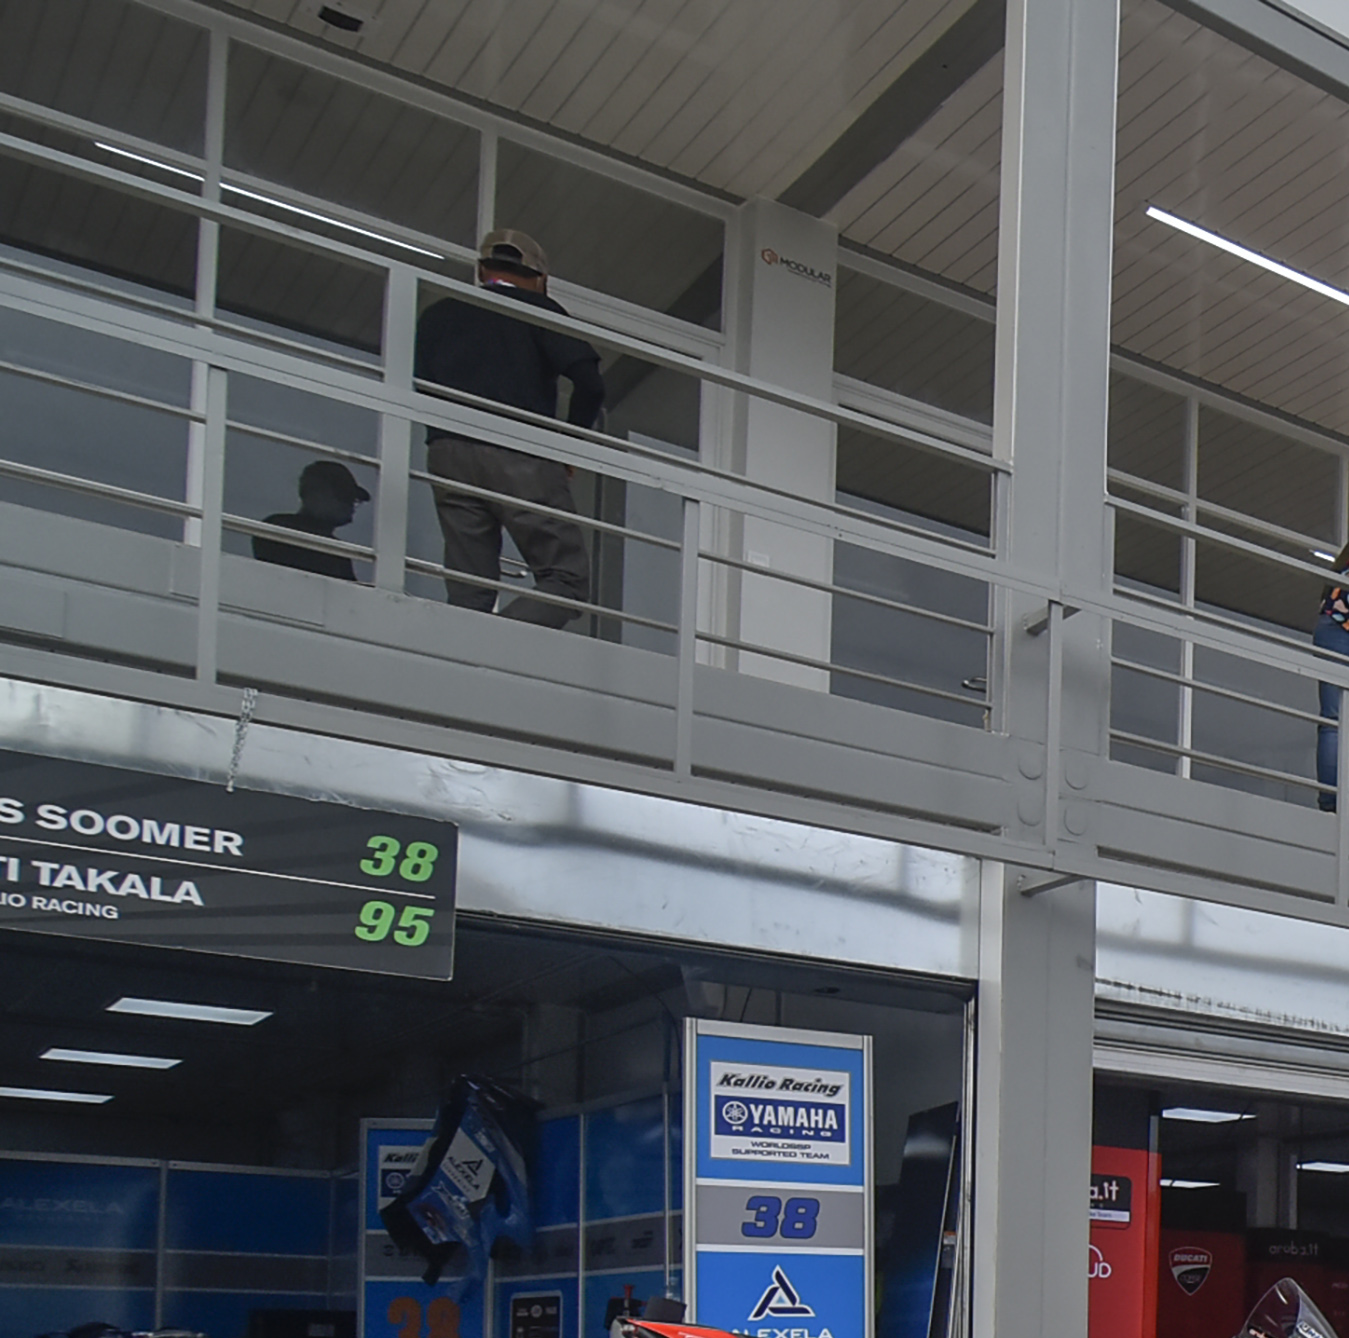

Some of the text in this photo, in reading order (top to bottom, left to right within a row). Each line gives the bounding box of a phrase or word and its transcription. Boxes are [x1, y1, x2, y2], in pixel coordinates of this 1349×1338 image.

[780, 257, 832, 284] MODULAR
[35, 804, 244, 857] SOOMER
[360, 835, 439, 882] 38
[31, 860, 205, 907] TAKALA
[32, 896, 119, 919] RACING
[355, 901, 434, 946] 95
[717, 1073, 843, 1097] Kallio Racing
[750, 1104, 838, 1130] YAMAHA
[732, 1126, 832, 1137] RACING
[800, 1151, 829, 1159] TEAM
[741, 1196, 820, 1239] 38
[1173, 1253, 1208, 1263] DUCATI
